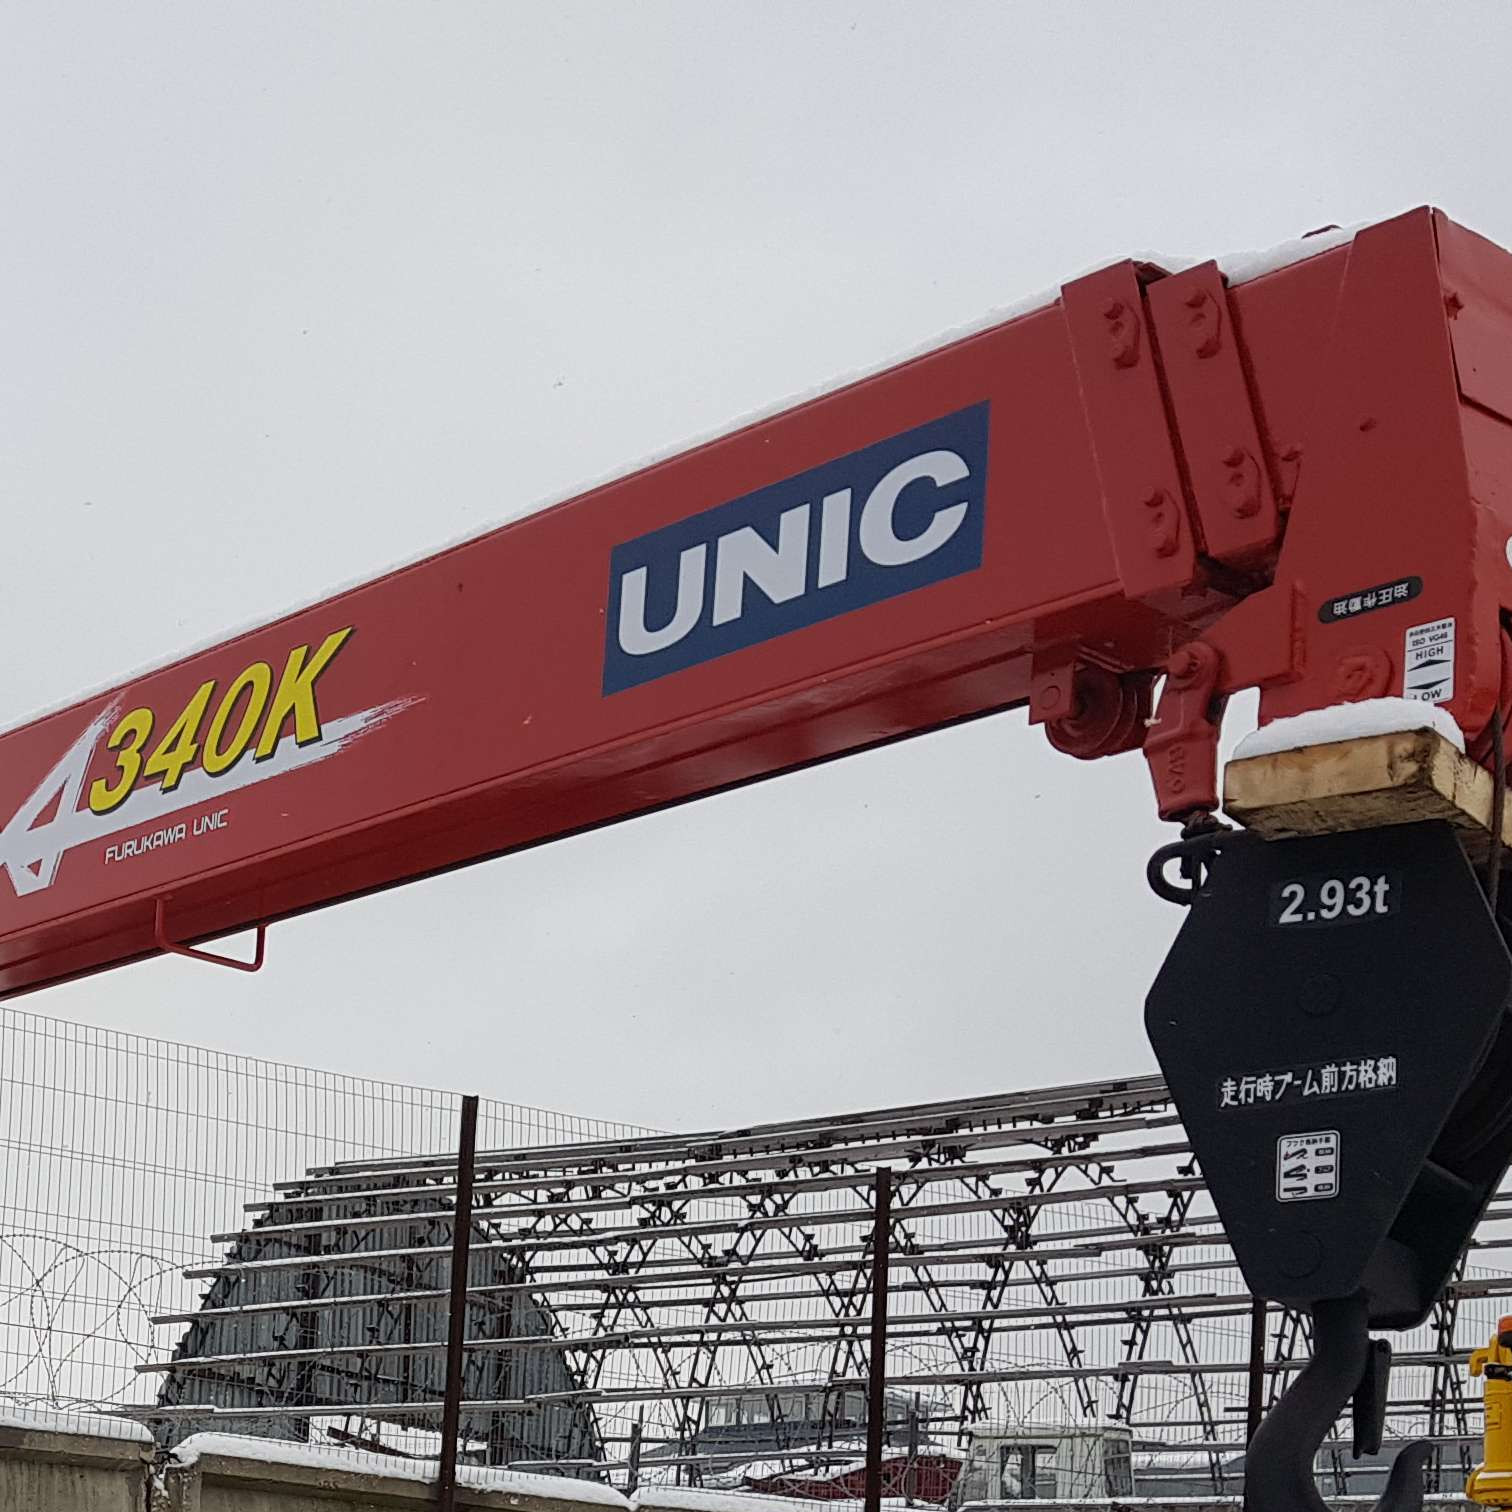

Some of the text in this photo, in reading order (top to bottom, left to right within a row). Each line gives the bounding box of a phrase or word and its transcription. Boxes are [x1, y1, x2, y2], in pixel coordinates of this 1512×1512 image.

[618, 449, 970, 656] UNIC
[1415, 647, 1443, 660] HIGH
[89, 626, 357, 814] 340K
[104, 809, 229, 865] FURUKAWA UNIC
[1278, 874, 1391, 925] 2.93t
[1220, 1056, 1398, 1108] 走行時ブーム前方格納
